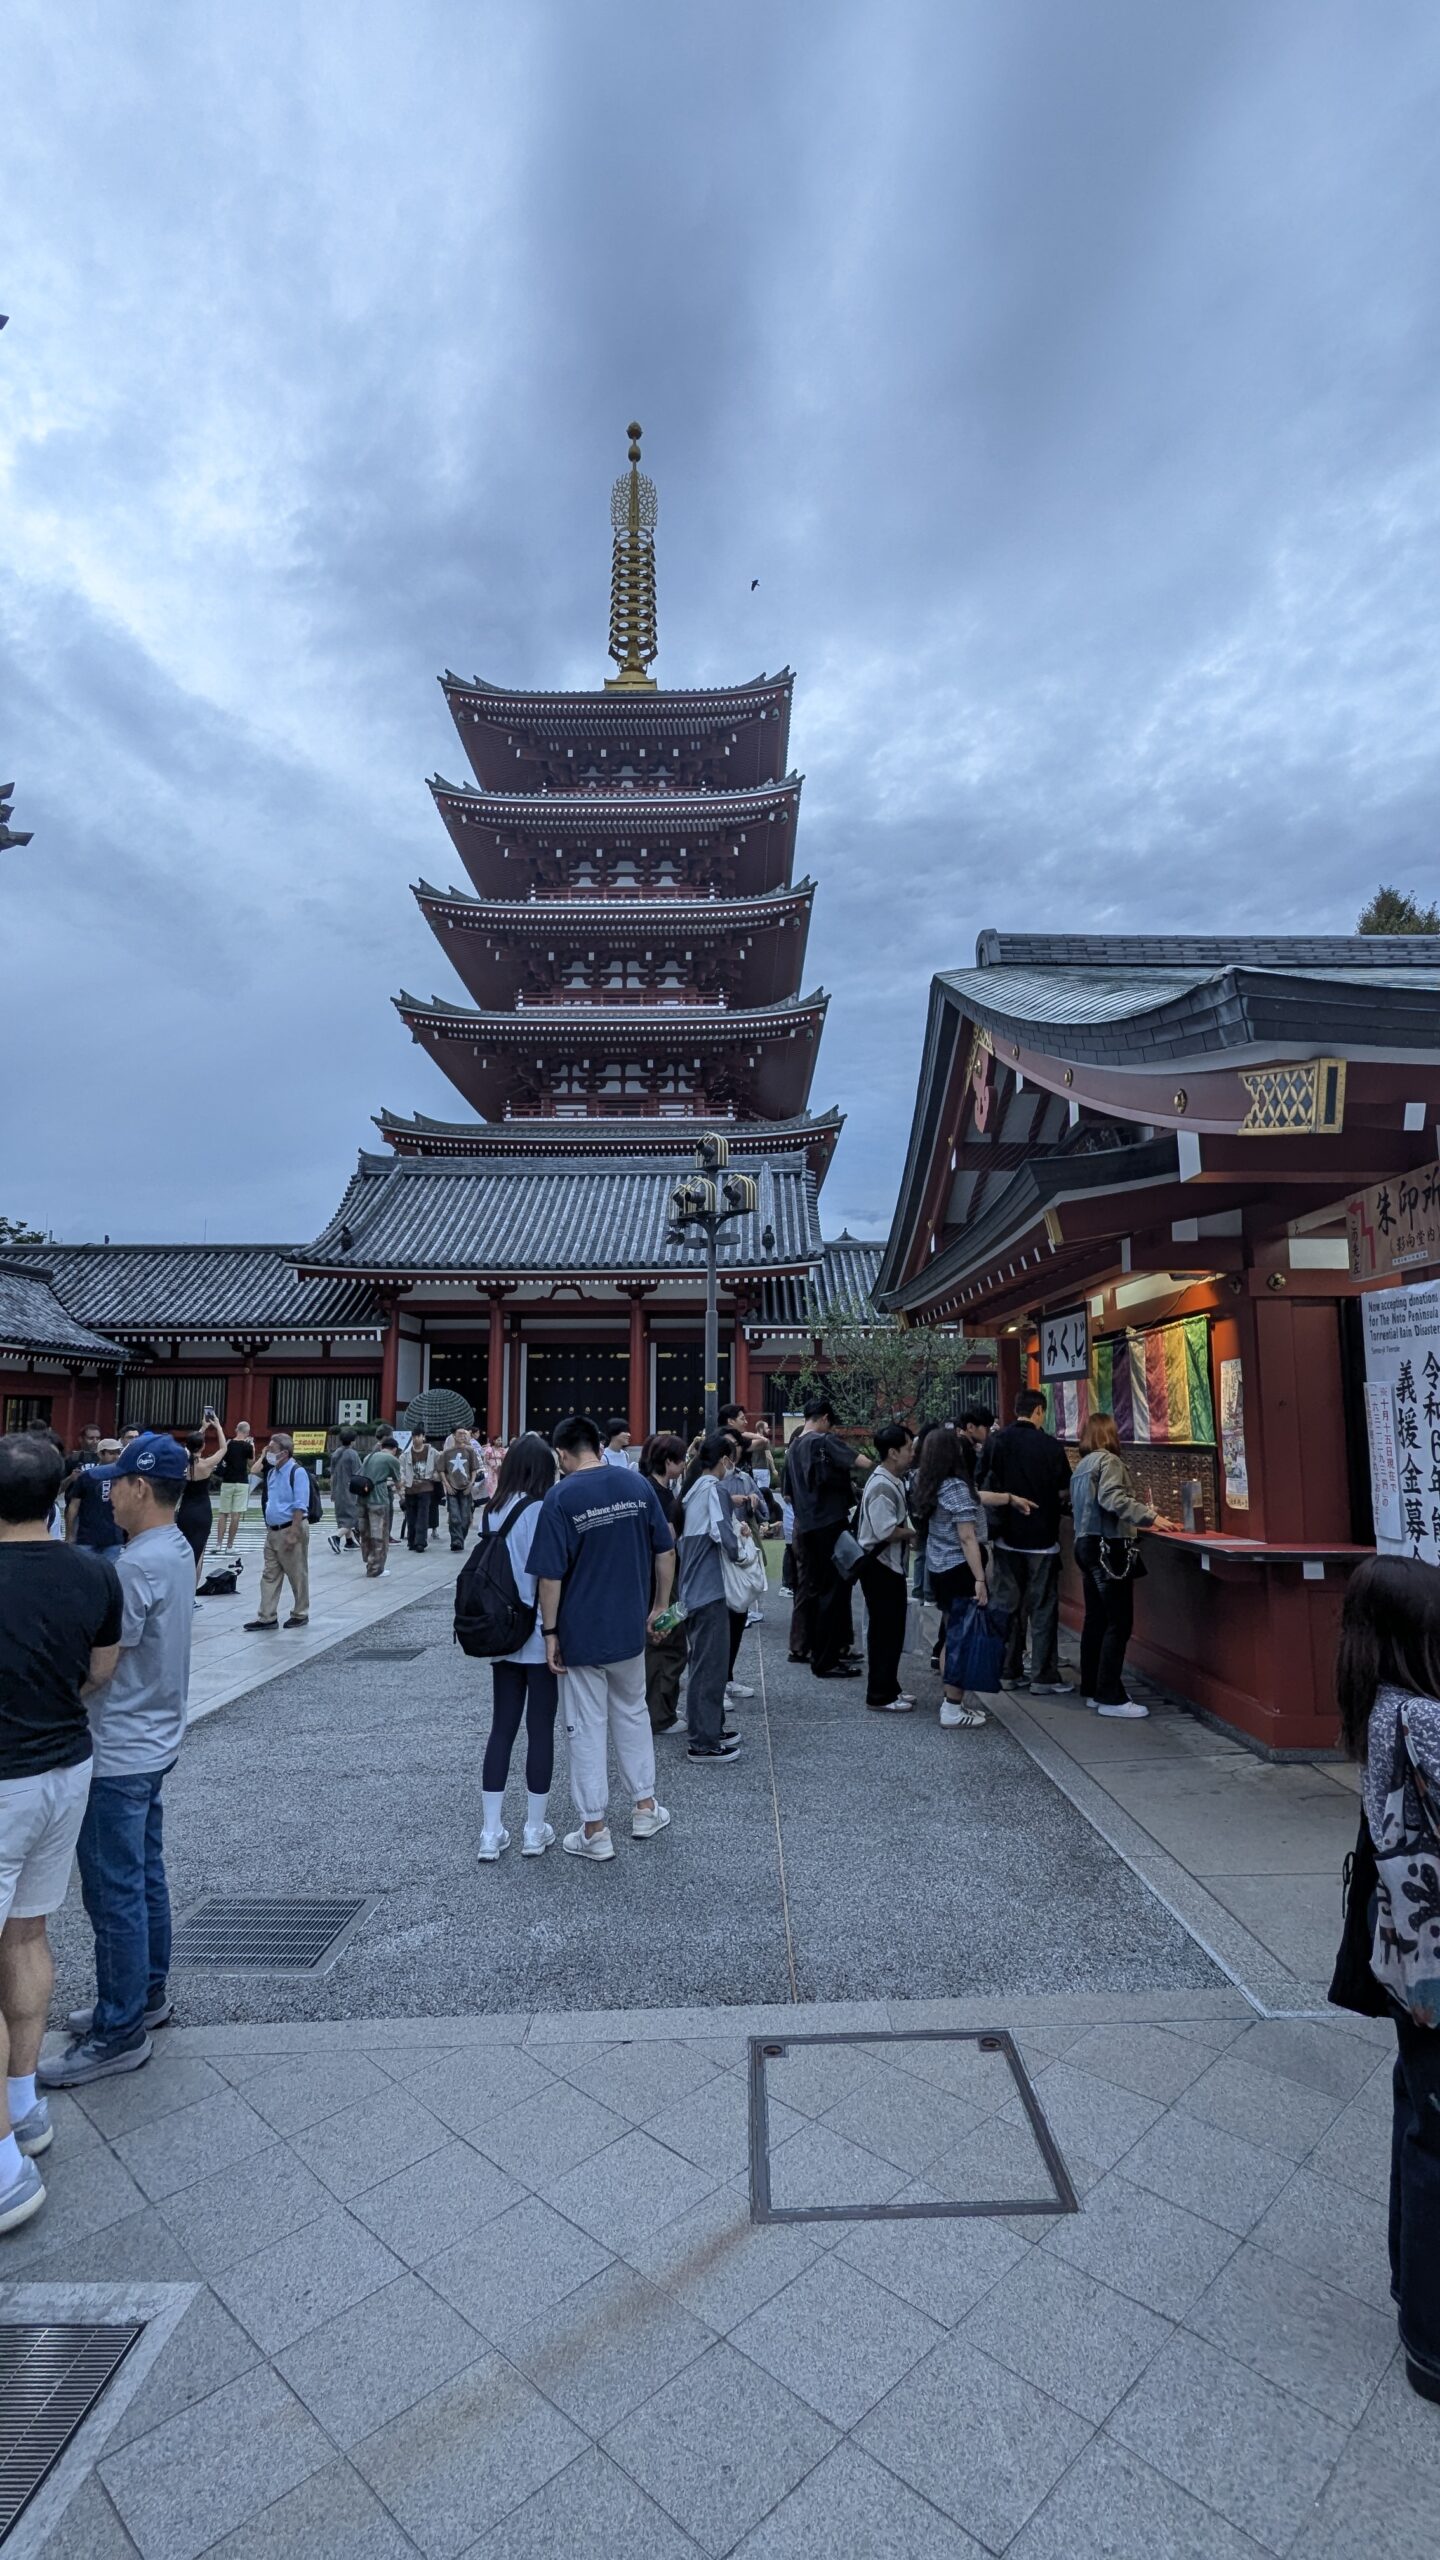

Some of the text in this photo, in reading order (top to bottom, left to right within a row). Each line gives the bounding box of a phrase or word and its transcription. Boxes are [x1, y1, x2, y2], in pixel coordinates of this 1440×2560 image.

[1368, 1292, 1439, 1312] Now accepting donations
[1369, 1306, 1439, 1327] for The Noto Peninsula
[1369, 1327, 1399, 1341] Torrential
[1399, 1326, 1413, 1338] Rain
[1047, 1321, 1085, 1367] みくじ
[572, 1513, 587, 1524] New
[586, 1507, 611, 1518] Balance
